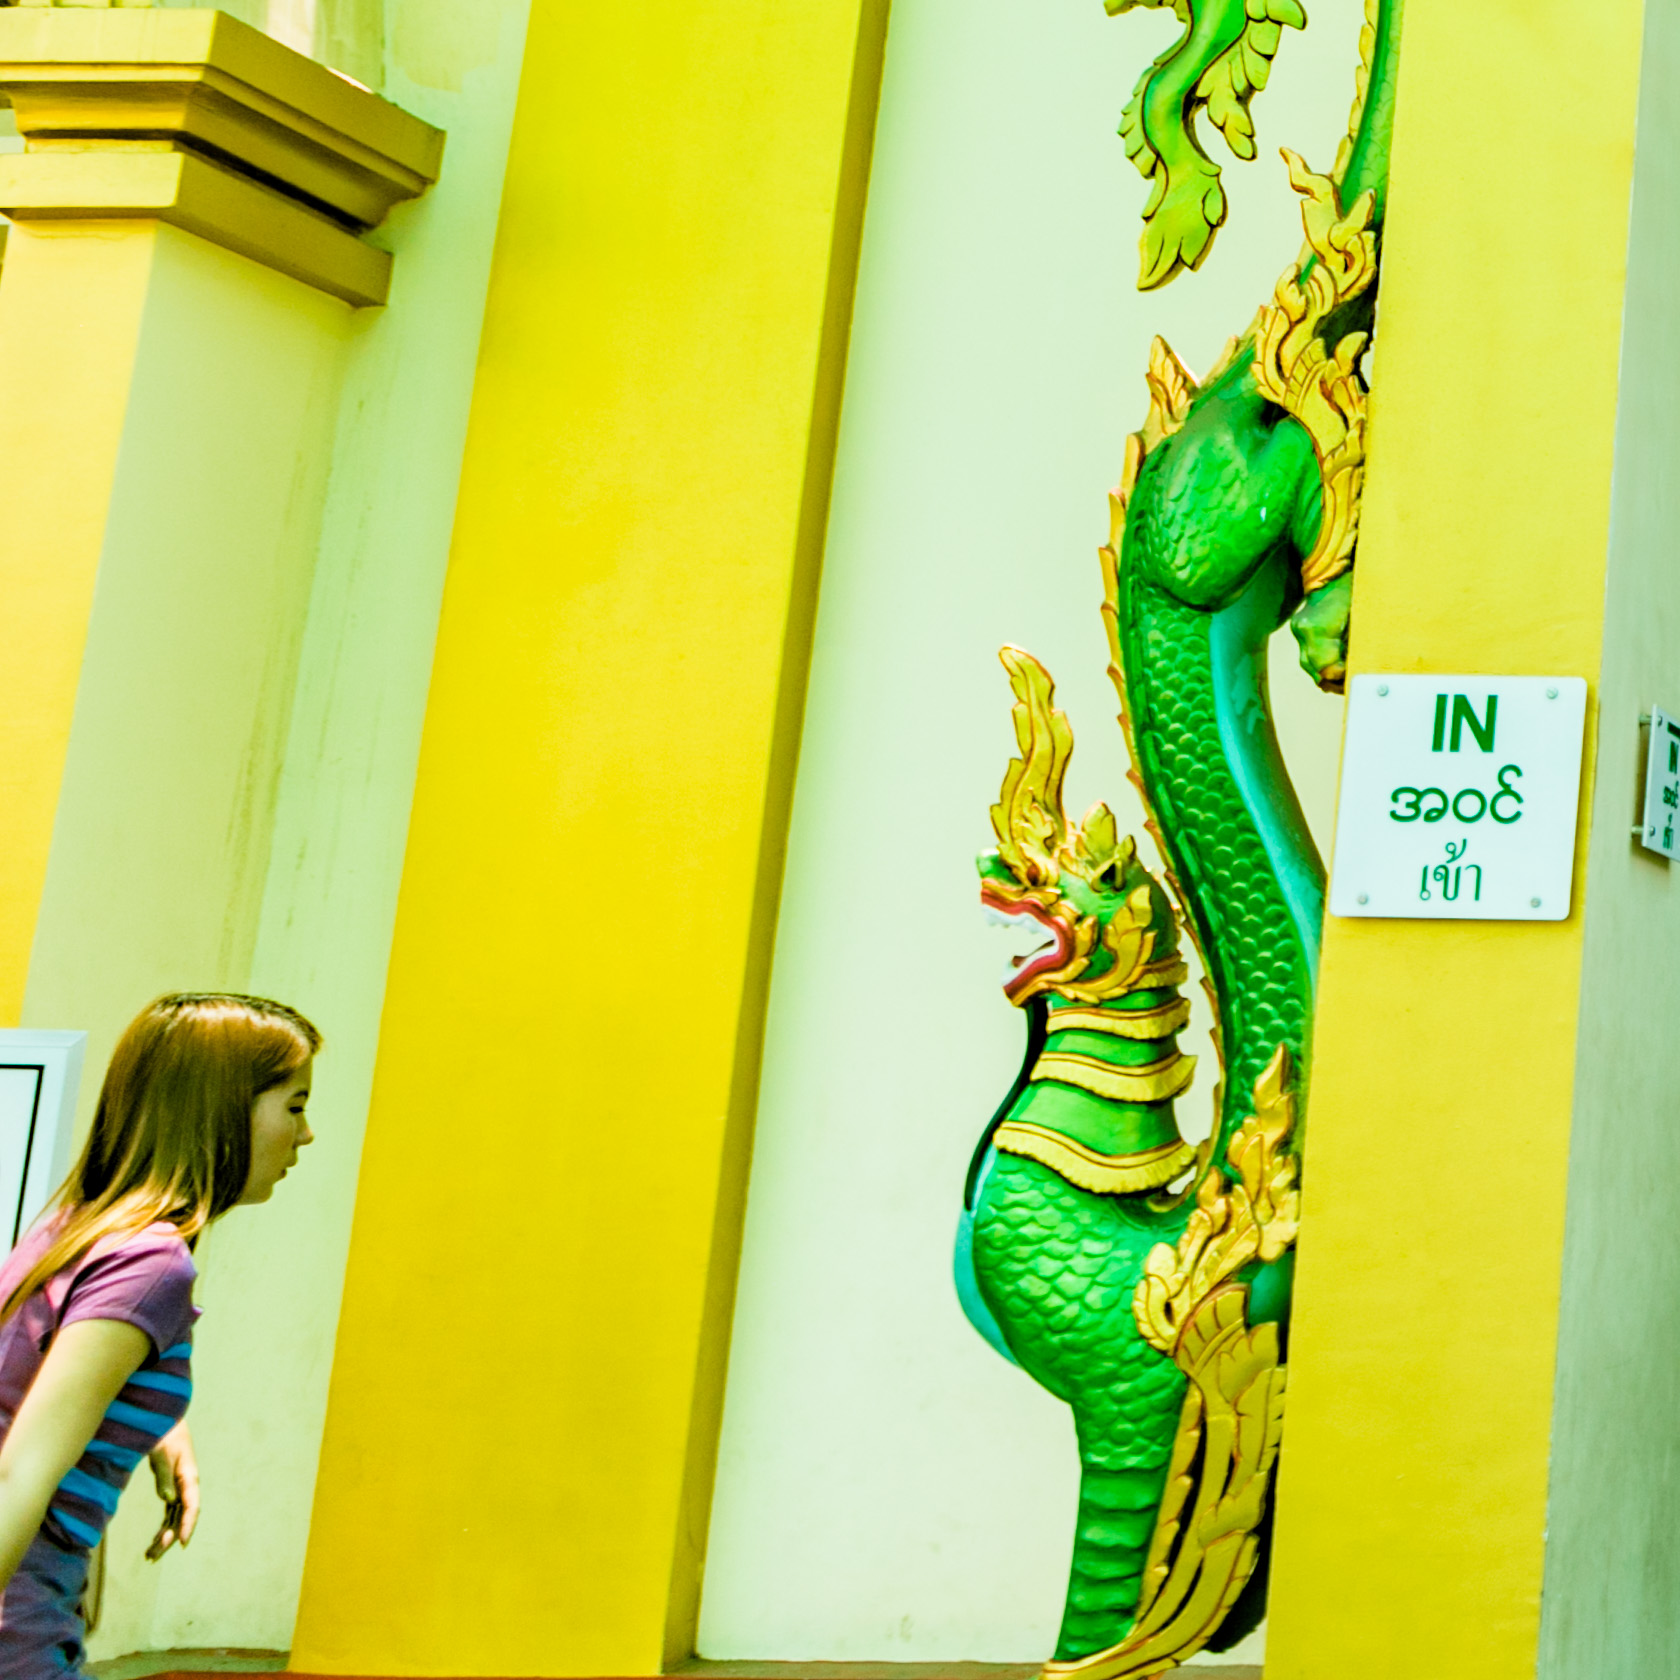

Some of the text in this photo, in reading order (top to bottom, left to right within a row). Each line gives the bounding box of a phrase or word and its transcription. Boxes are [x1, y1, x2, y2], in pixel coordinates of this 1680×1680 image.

[1432, 694, 1498, 752] IN
[1389, 764, 1524, 824] အဝင်
[1419, 838, 1482, 901] เข้า
